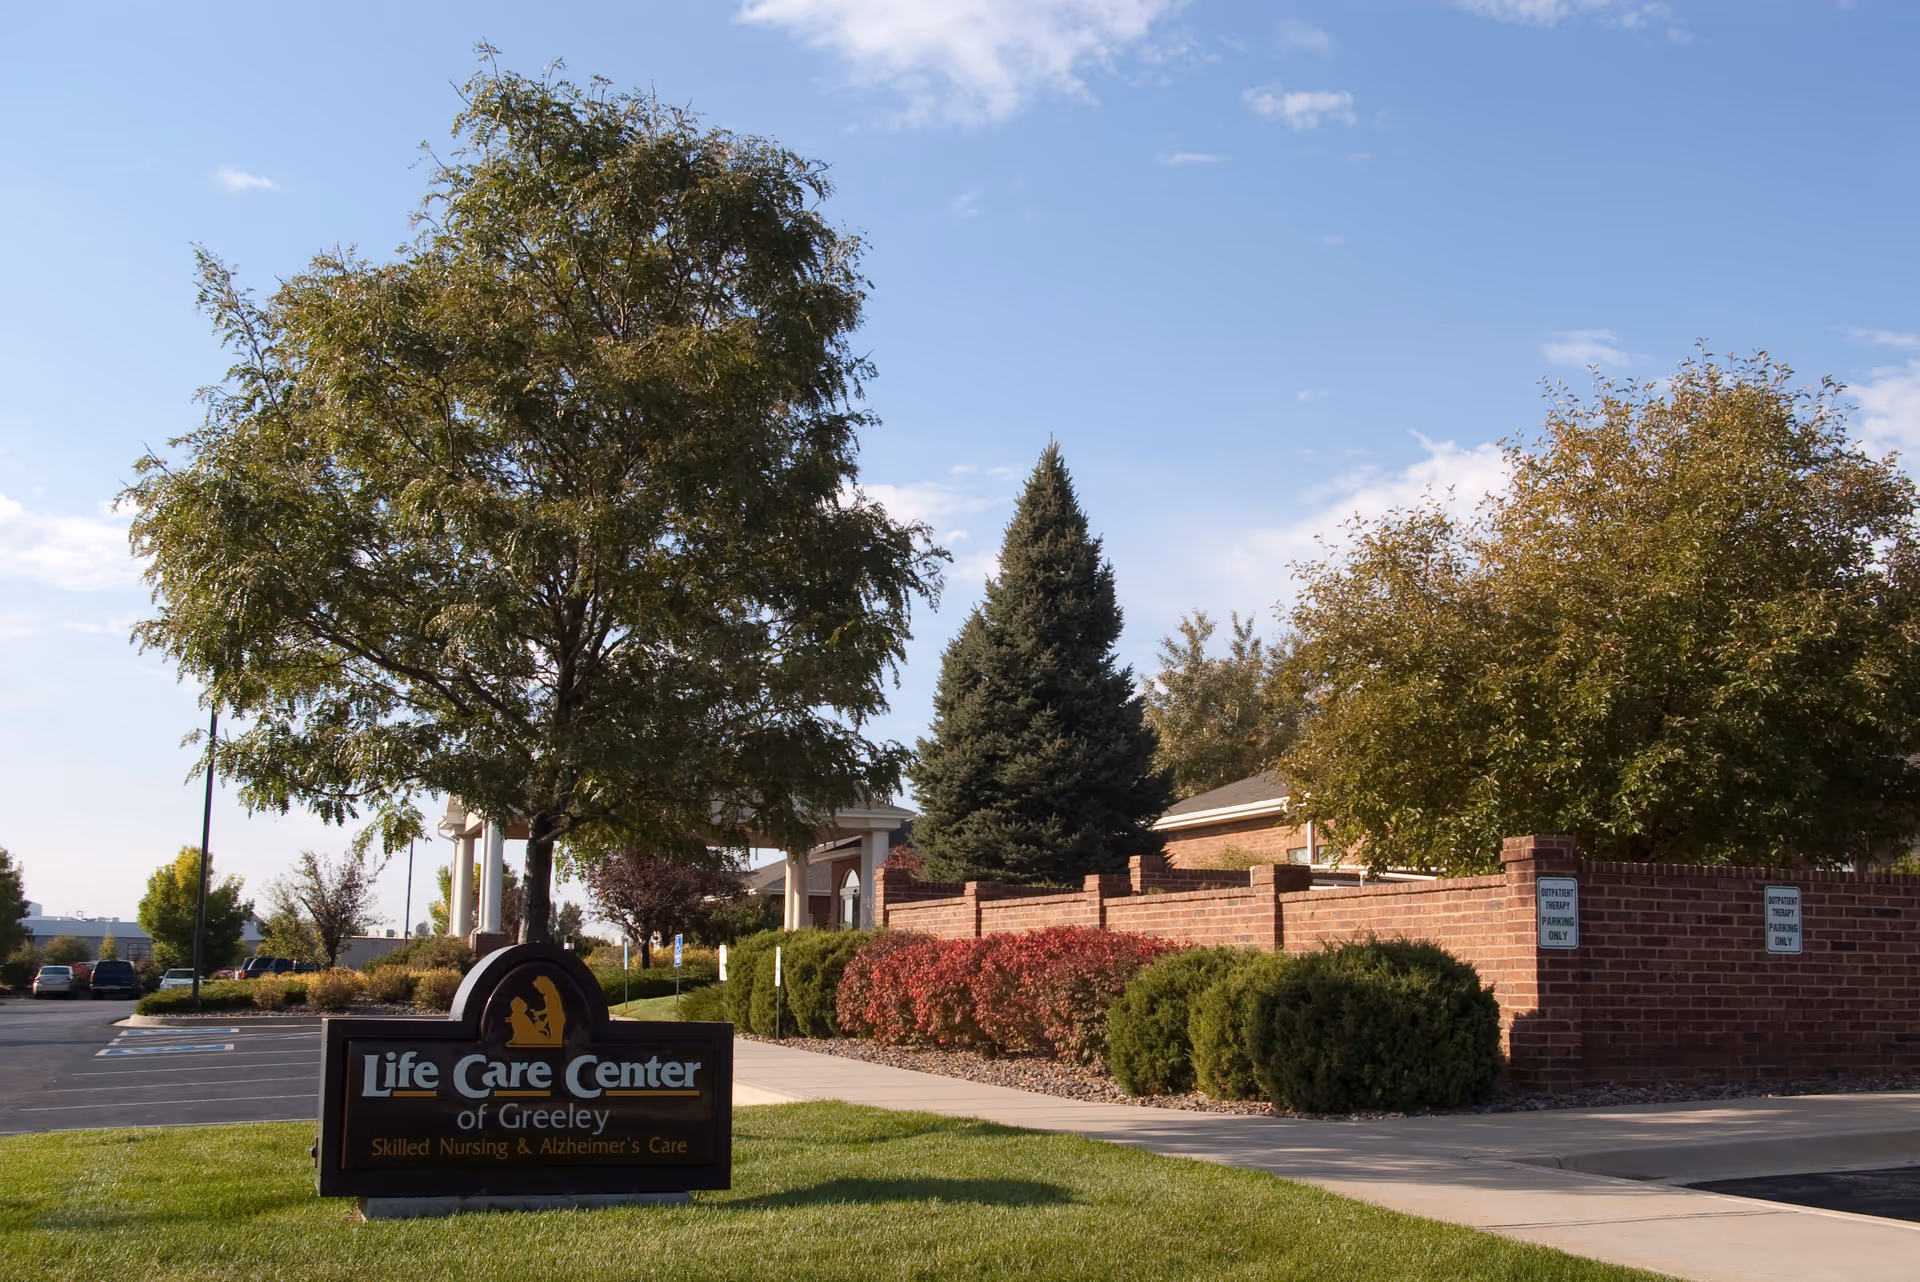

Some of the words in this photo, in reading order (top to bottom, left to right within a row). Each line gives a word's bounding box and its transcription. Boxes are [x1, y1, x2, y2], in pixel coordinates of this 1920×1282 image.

[1541, 888, 1574, 897] OUTPATIENT
[1545, 901, 1570, 910] THERAPY
[1768, 896, 1798, 905] OUTPATIENT
[1772, 908, 1795, 917] THERAPY
[1541, 916, 1575, 927] PARKING
[1768, 923, 1799, 933] PARKING
[1548, 930, 1568, 941] ONLY
[1775, 936, 1793, 946] ONLY
[361, 1050, 440, 1097] Life
[453, 1054, 552, 1099] Care
[565, 1054, 702, 1098] Center
[456, 1103, 487, 1129] of
[499, 1103, 610, 1135] Greeley
[371, 1137, 430, 1156] Skilled
[440, 1138, 508, 1160] Nursing
[517, 1138, 531, 1155] &
[540, 1136, 640, 1155] Alzheimer's
[649, 1136, 688, 1154] Care
